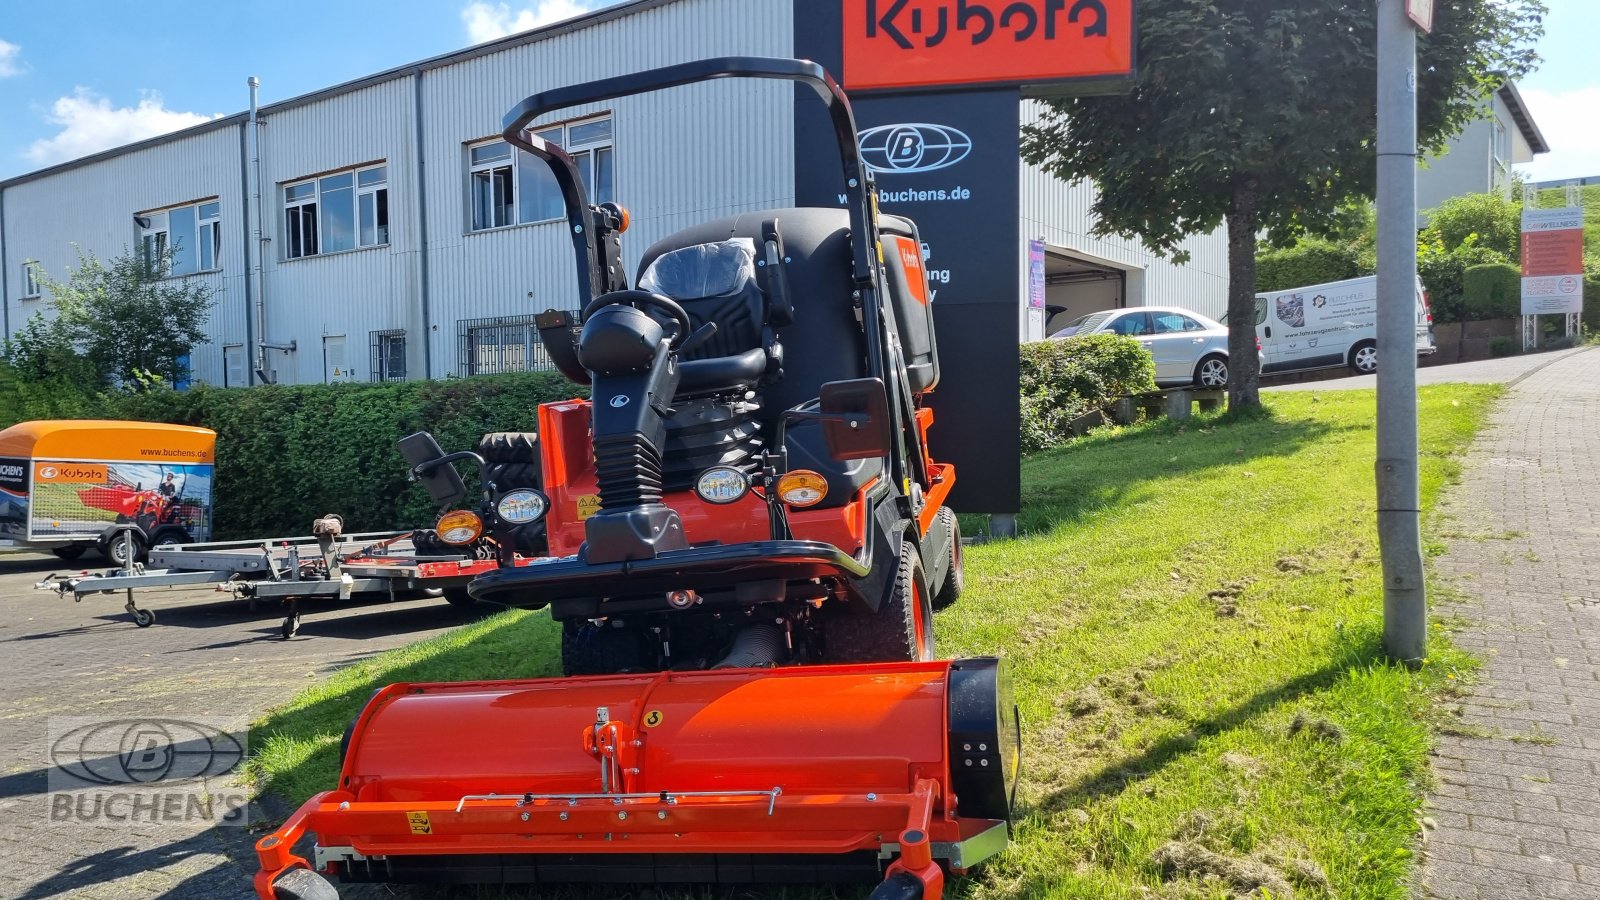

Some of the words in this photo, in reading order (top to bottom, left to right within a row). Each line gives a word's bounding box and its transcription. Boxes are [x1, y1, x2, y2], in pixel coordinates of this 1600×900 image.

[865, 0, 1108, 50] Kubota
[838, 186, 971, 204] wbuchens.de
[140, 448, 207, 458] www.buchens.de
[60, 468, 103, 480] Kubota
